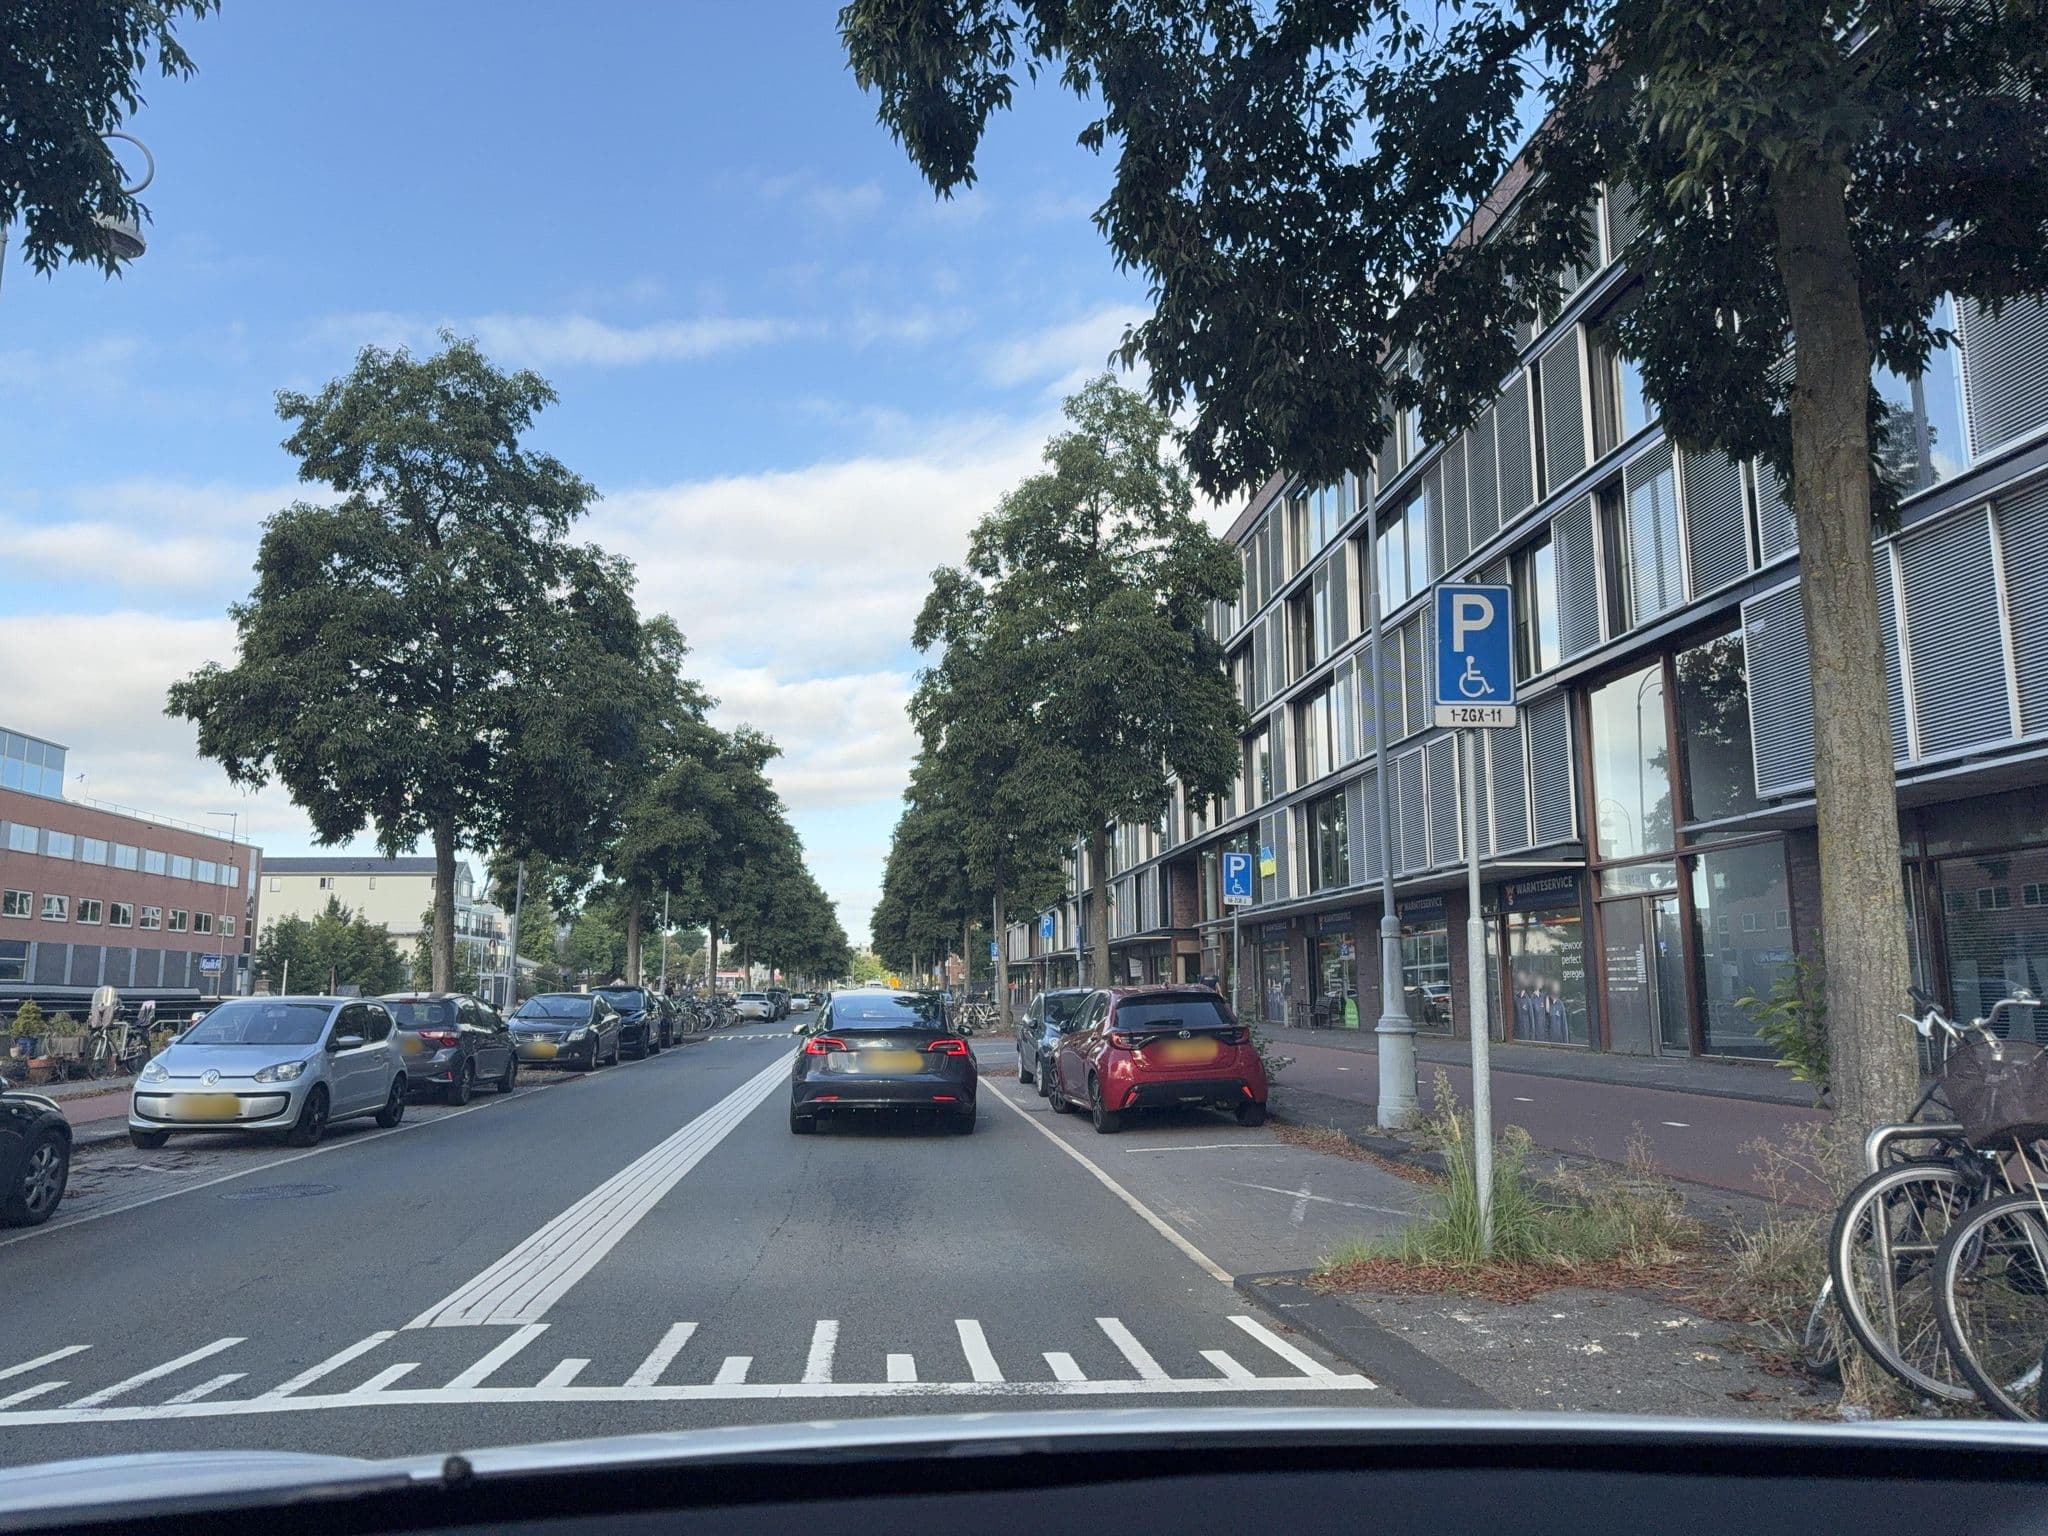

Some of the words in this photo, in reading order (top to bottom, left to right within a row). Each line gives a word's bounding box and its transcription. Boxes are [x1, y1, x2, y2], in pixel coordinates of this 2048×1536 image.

[1453, 594, 1494, 652] P
[1450, 708, 1502, 722] 1-ZGX-11
[1230, 856, 1246, 878] P
[1516, 875, 1574, 895] WARMTESERVICE
[1562, 954, 1582, 967] perfect
